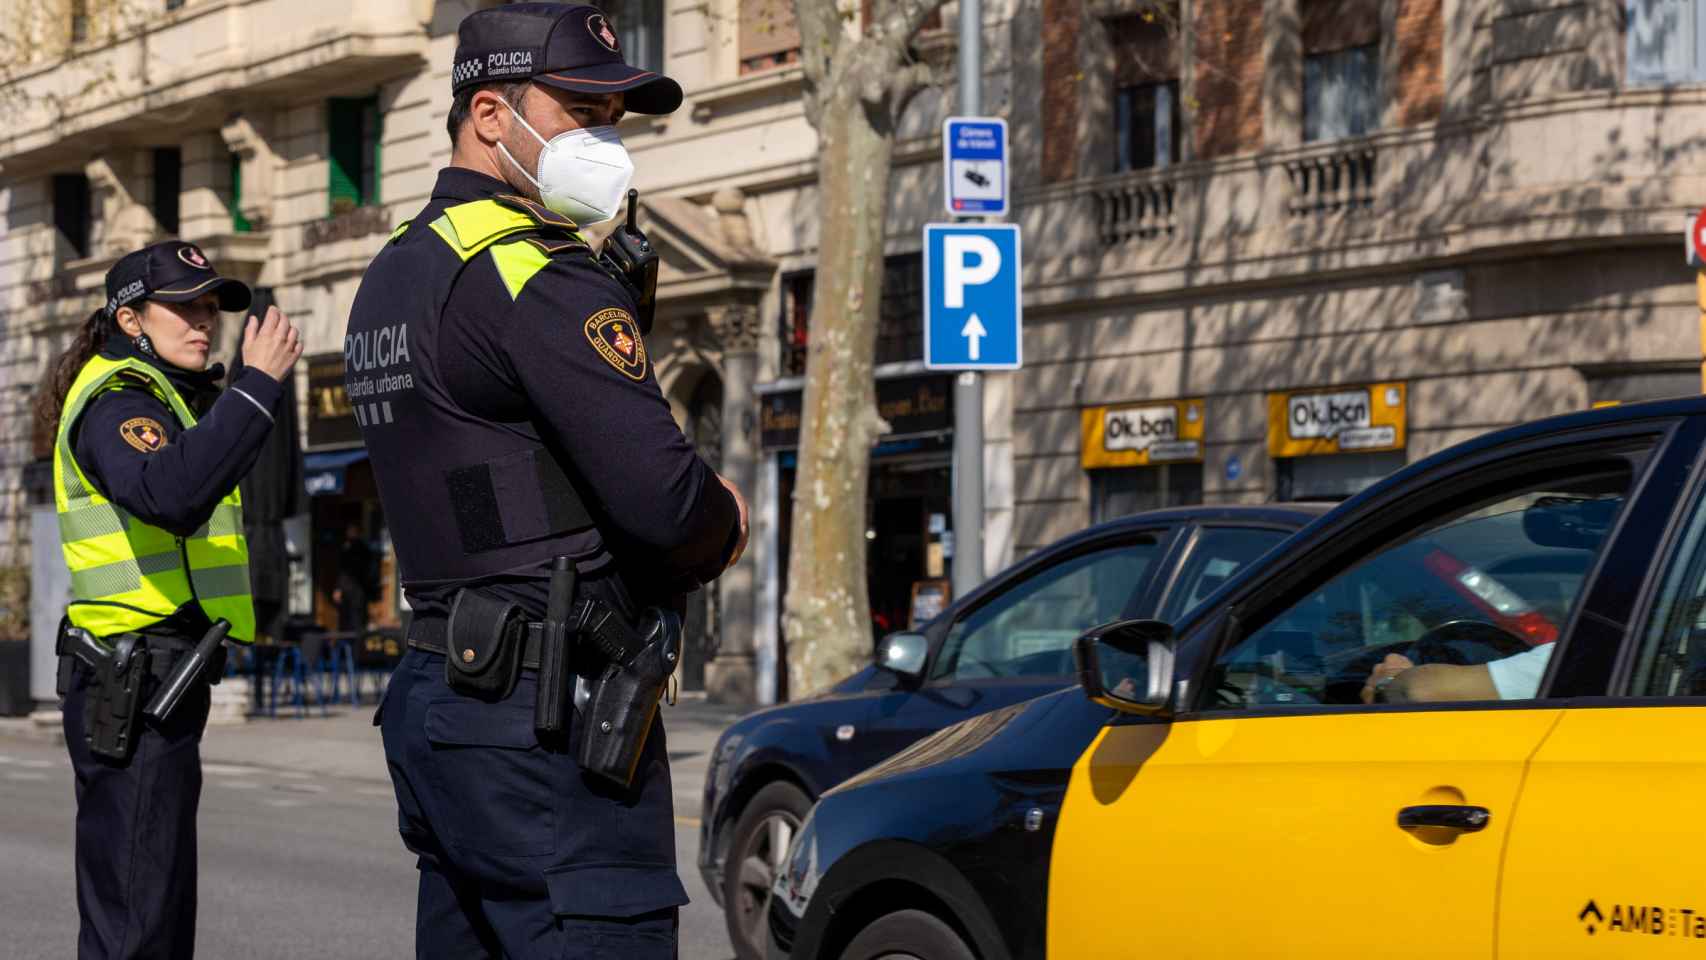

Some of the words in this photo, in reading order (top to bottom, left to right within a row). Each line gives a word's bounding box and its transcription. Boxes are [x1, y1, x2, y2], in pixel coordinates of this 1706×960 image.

[488, 51, 532, 67] POLICIA
[943, 234, 1002, 309] P
[344, 323, 411, 373] POLICIA
[376, 372, 414, 394] urbana
[1607, 904, 1665, 935] AMB
